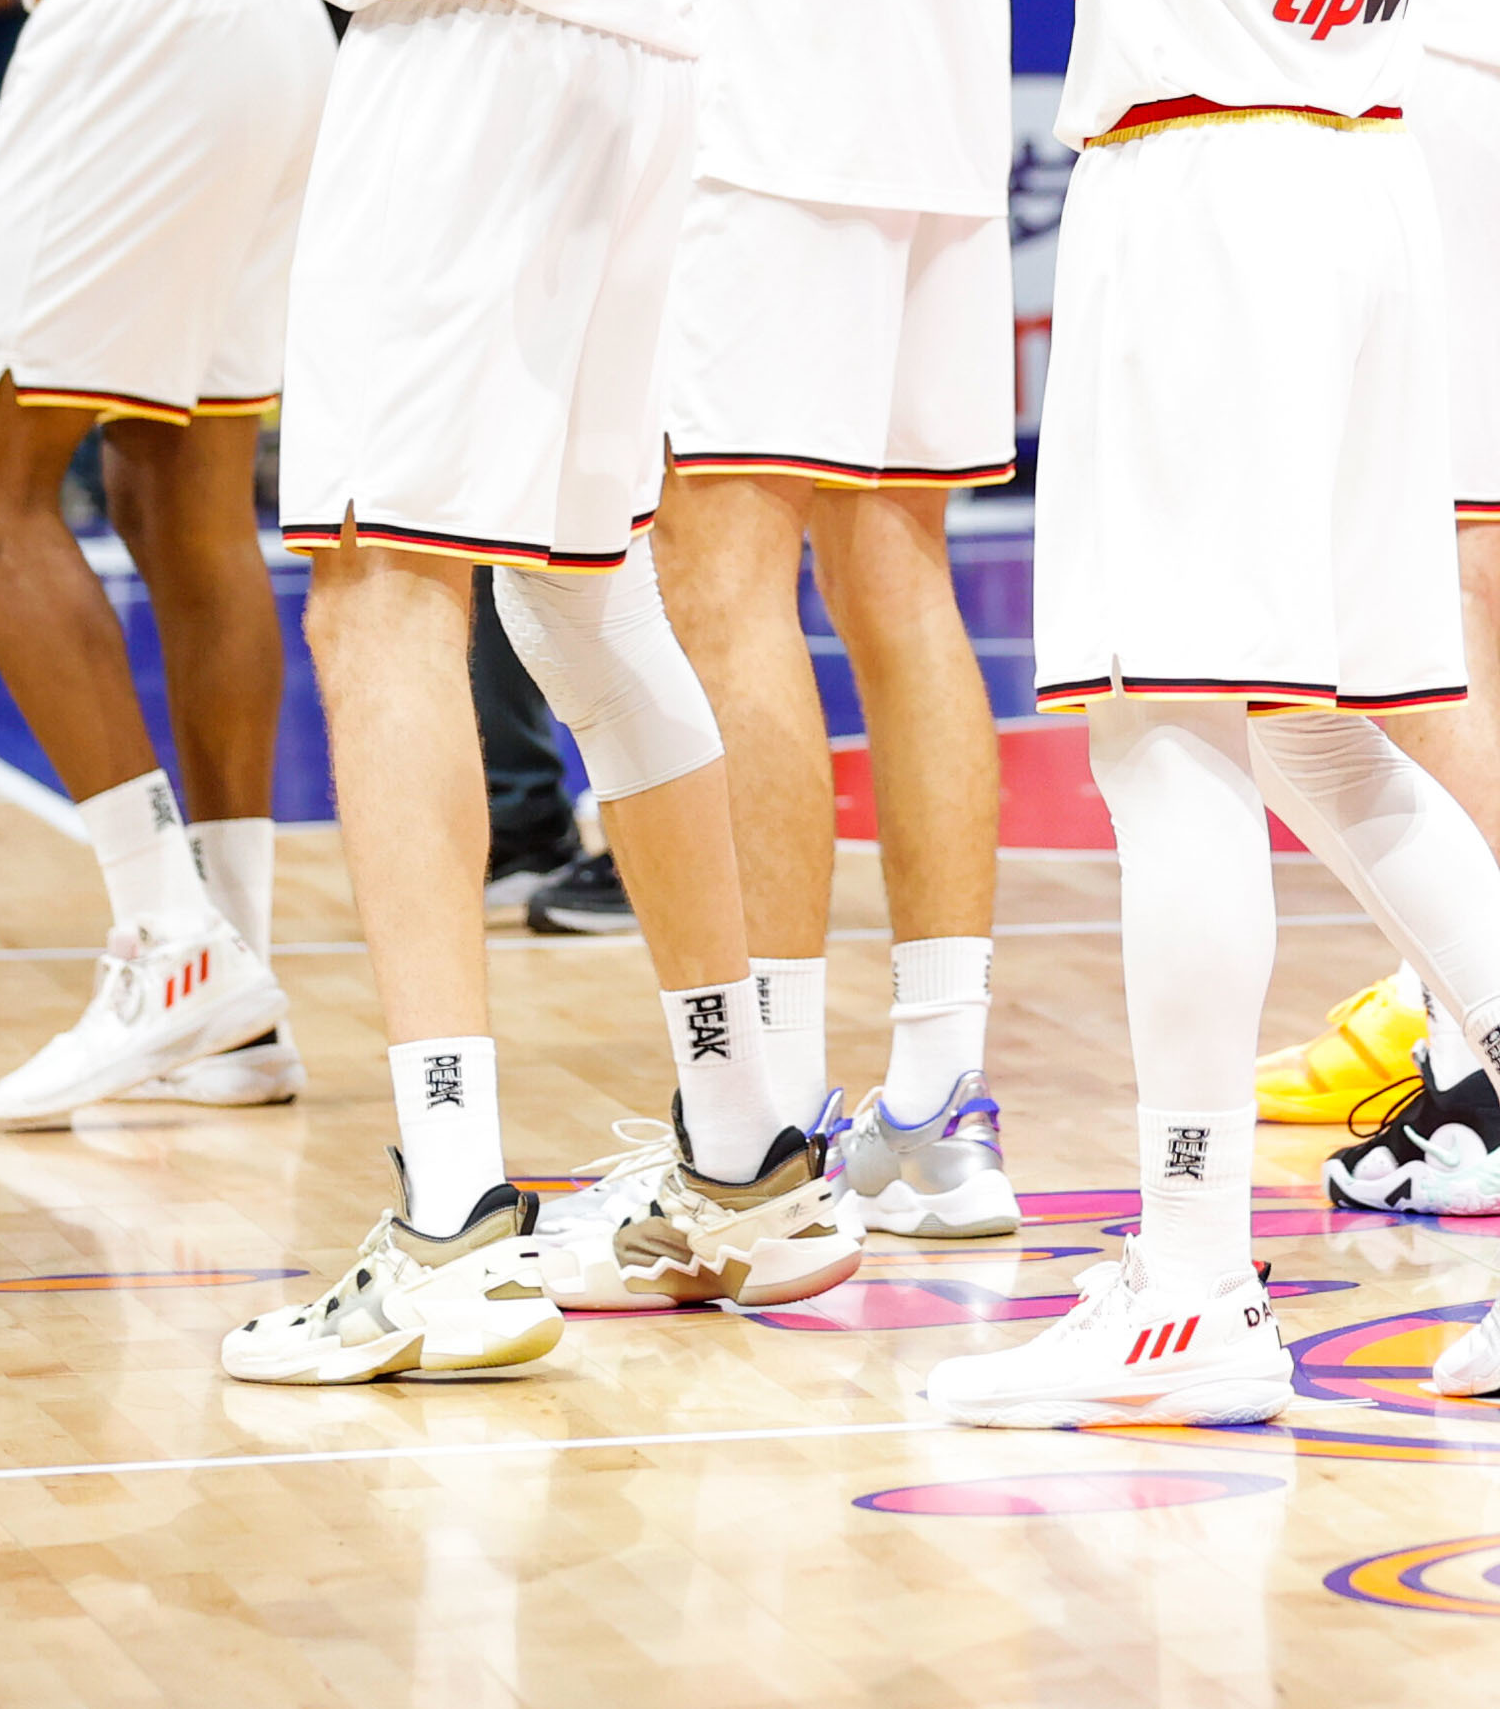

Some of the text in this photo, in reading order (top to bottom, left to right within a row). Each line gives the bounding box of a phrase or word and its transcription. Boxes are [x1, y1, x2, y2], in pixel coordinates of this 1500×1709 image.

[683, 991, 733, 1062] PEAK
[423, 1052, 465, 1109] PEAK
[1164, 1125, 1211, 1182] PEAK
